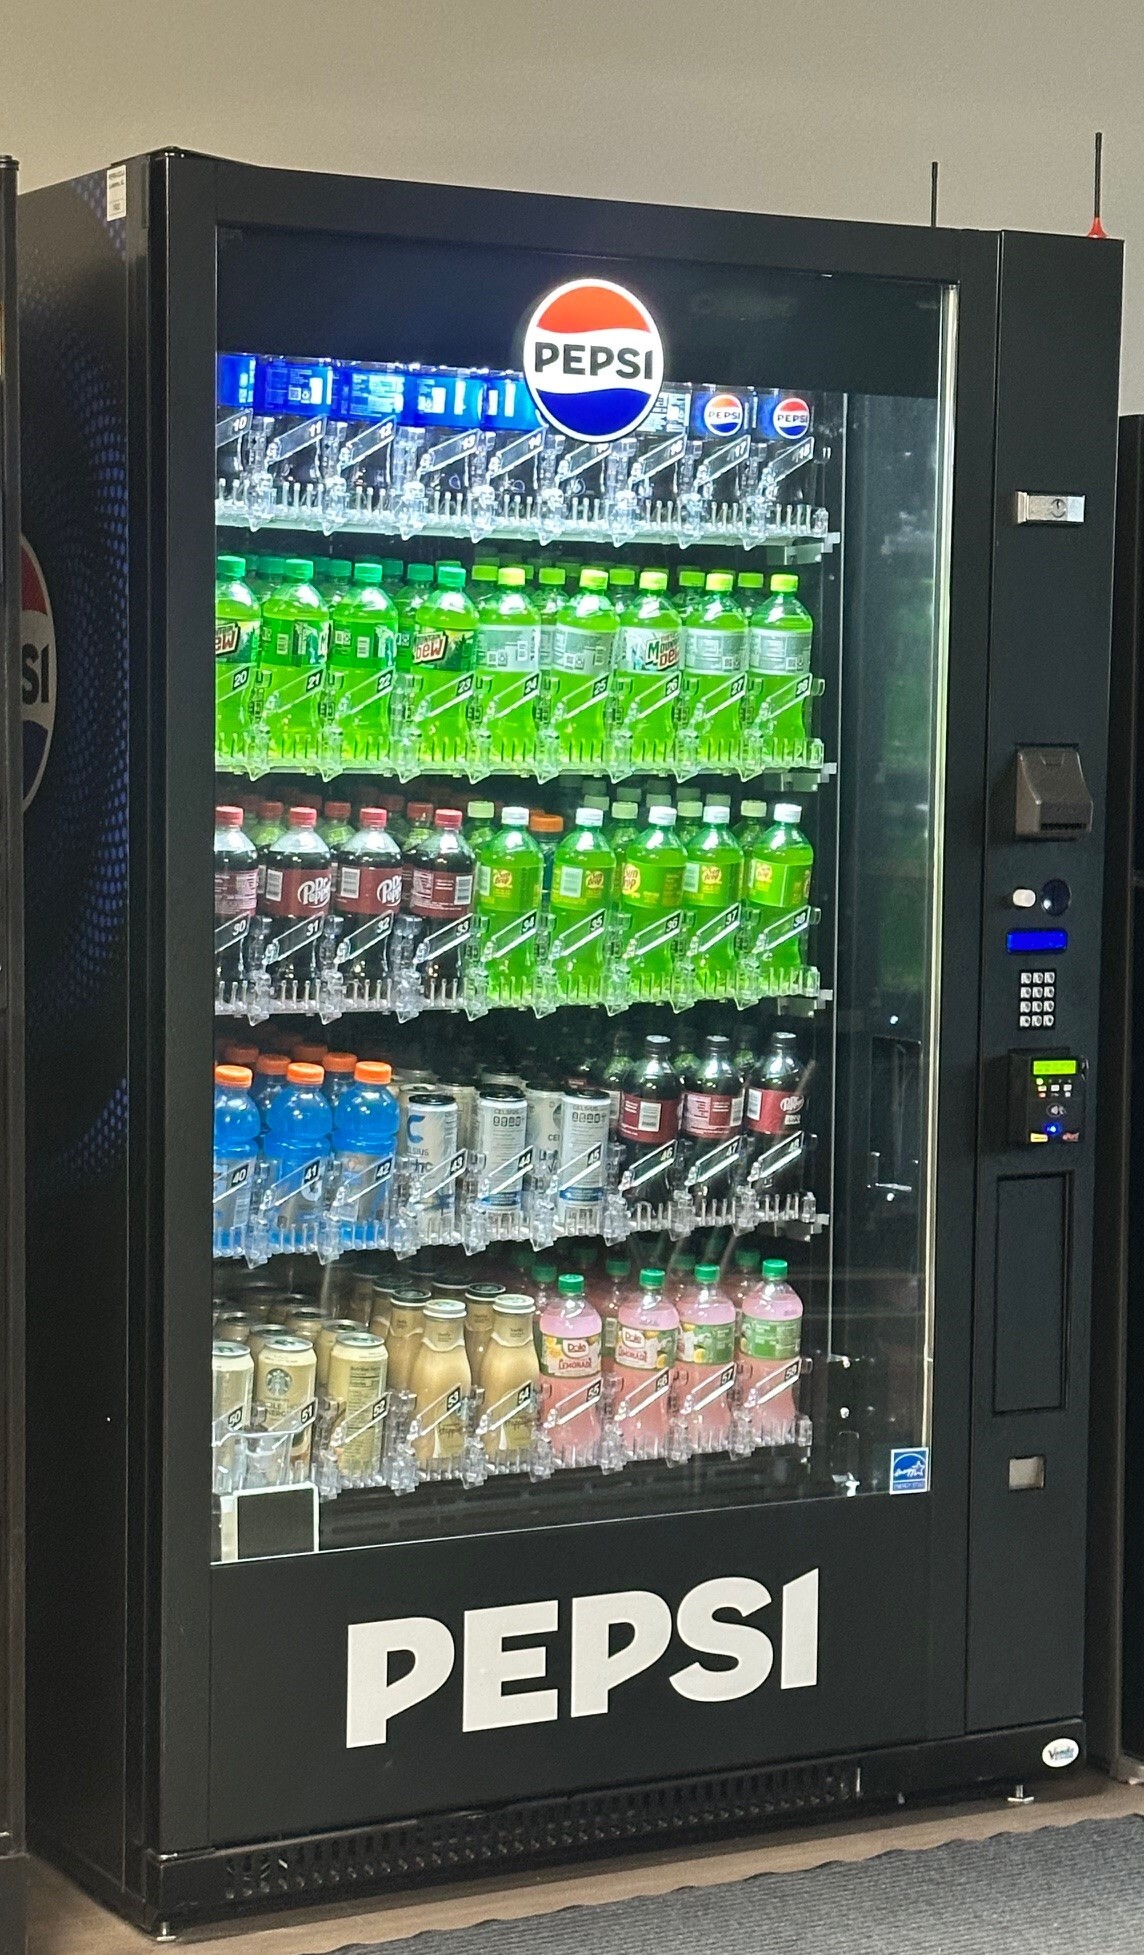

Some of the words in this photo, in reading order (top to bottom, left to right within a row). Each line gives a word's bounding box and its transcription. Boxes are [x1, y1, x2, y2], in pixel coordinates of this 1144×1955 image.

[534, 342, 653, 380] PEPSI
[709, 411, 740, 420] PEPSI
[778, 414, 808, 423] PEPSI
[233, 417, 247, 432] 10
[734, 442, 747, 455] 17
[234, 670, 247, 687] 20
[308, 672, 320, 688] 21
[378, 673, 391, 689] 22
[458, 677, 471, 691] 23
[525, 676, 538, 691] 24
[594, 678, 606, 693] 25
[731, 677, 744, 693] 27
[522, 916, 535, 931] 34
[590, 916, 603, 931] 35
[726, 911, 737, 924] 37
[233, 920, 246, 936] 30
[307, 920, 319, 936] 31
[377, 917, 390, 934] 32
[456, 921, 468, 936] 33
[587, 1151, 600, 1164] 45
[661, 1148, 672, 1161] 46
[726, 1143, 738, 1157] 47
[451, 1158, 463, 1173] 43
[519, 1154, 532, 1168] 44
[232, 1169, 246, 1183] 40
[305, 1165, 317, 1181] 41
[376, 1163, 390, 1179] 42
[625, 1331, 642, 1344] Dole
[567, 1343, 586, 1353] Dole
[722, 1370, 734, 1384] 57
[447, 1391, 459, 1408] 53
[518, 1389, 531, 1403] 54
[588, 1384, 600, 1400] 55
[302, 1407, 313, 1422] 51
[374, 1401, 386, 1418] 52
[228, 1411, 241, 1426] 50
[346, 1567, 820, 1749] PEPSI
